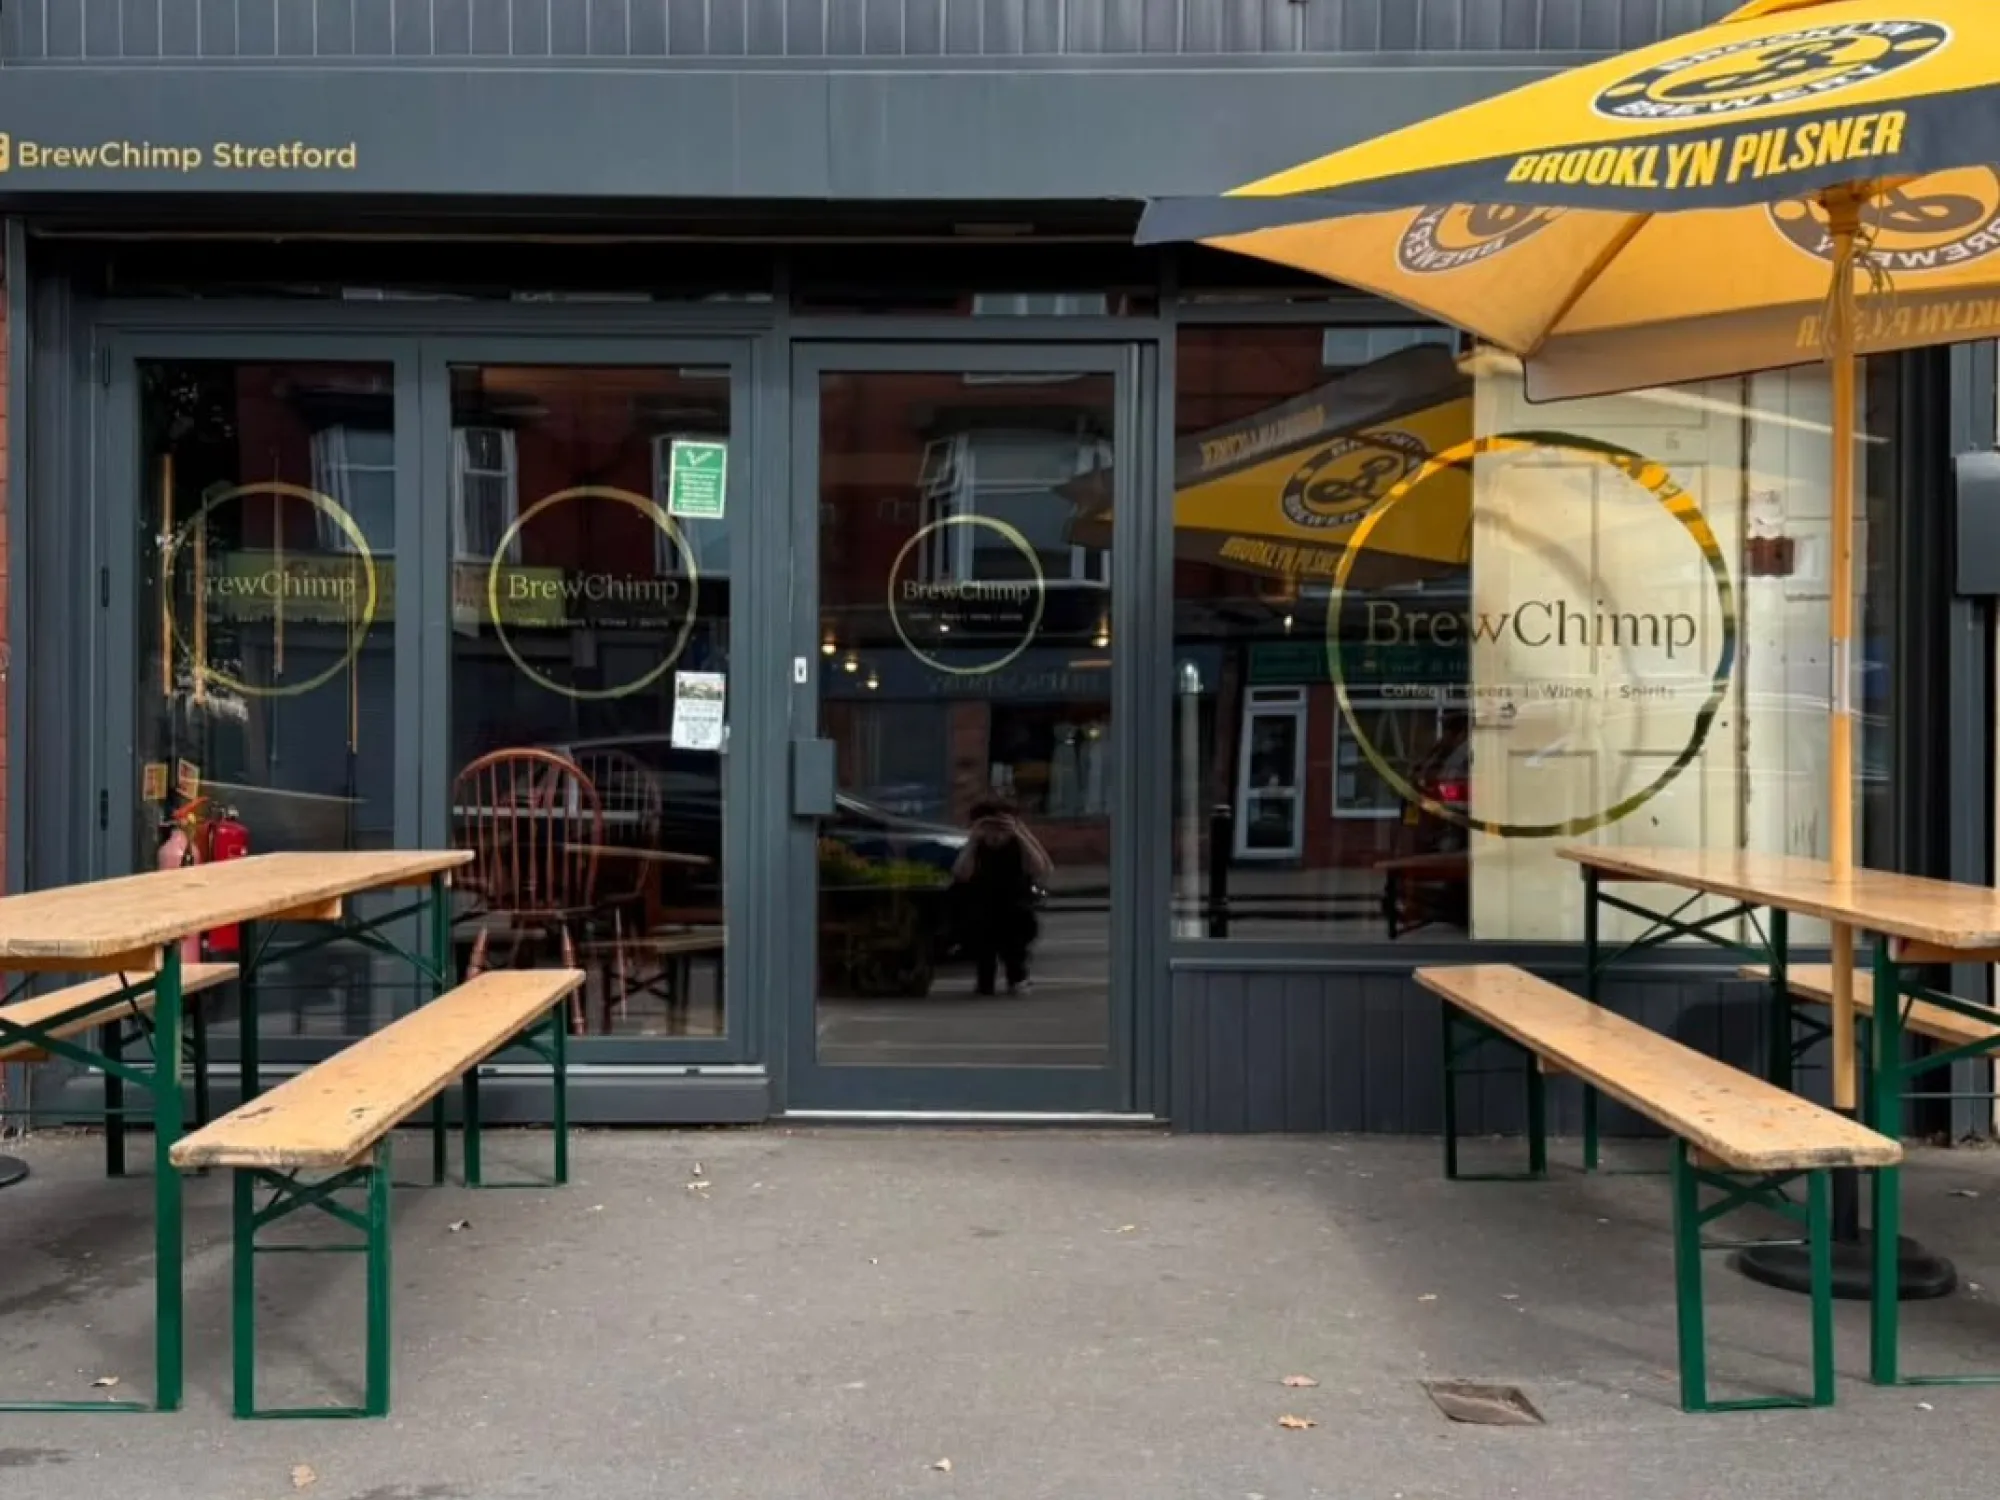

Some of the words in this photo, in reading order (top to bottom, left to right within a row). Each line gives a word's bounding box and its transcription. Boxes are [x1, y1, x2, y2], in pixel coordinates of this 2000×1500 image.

[1611, 64, 1882, 117] BREWERY
[18, 141, 202, 173] BrewChimp
[212, 141, 357, 169] Stretford
[1505, 138, 1725, 190] BROOKLYN
[1725, 110, 1908, 184] PILSNER
[508, 573, 679, 606] BrewChimp
[902, 579, 1030, 606] BrewChimp
[1363, 599, 1697, 660] BrewChimp
